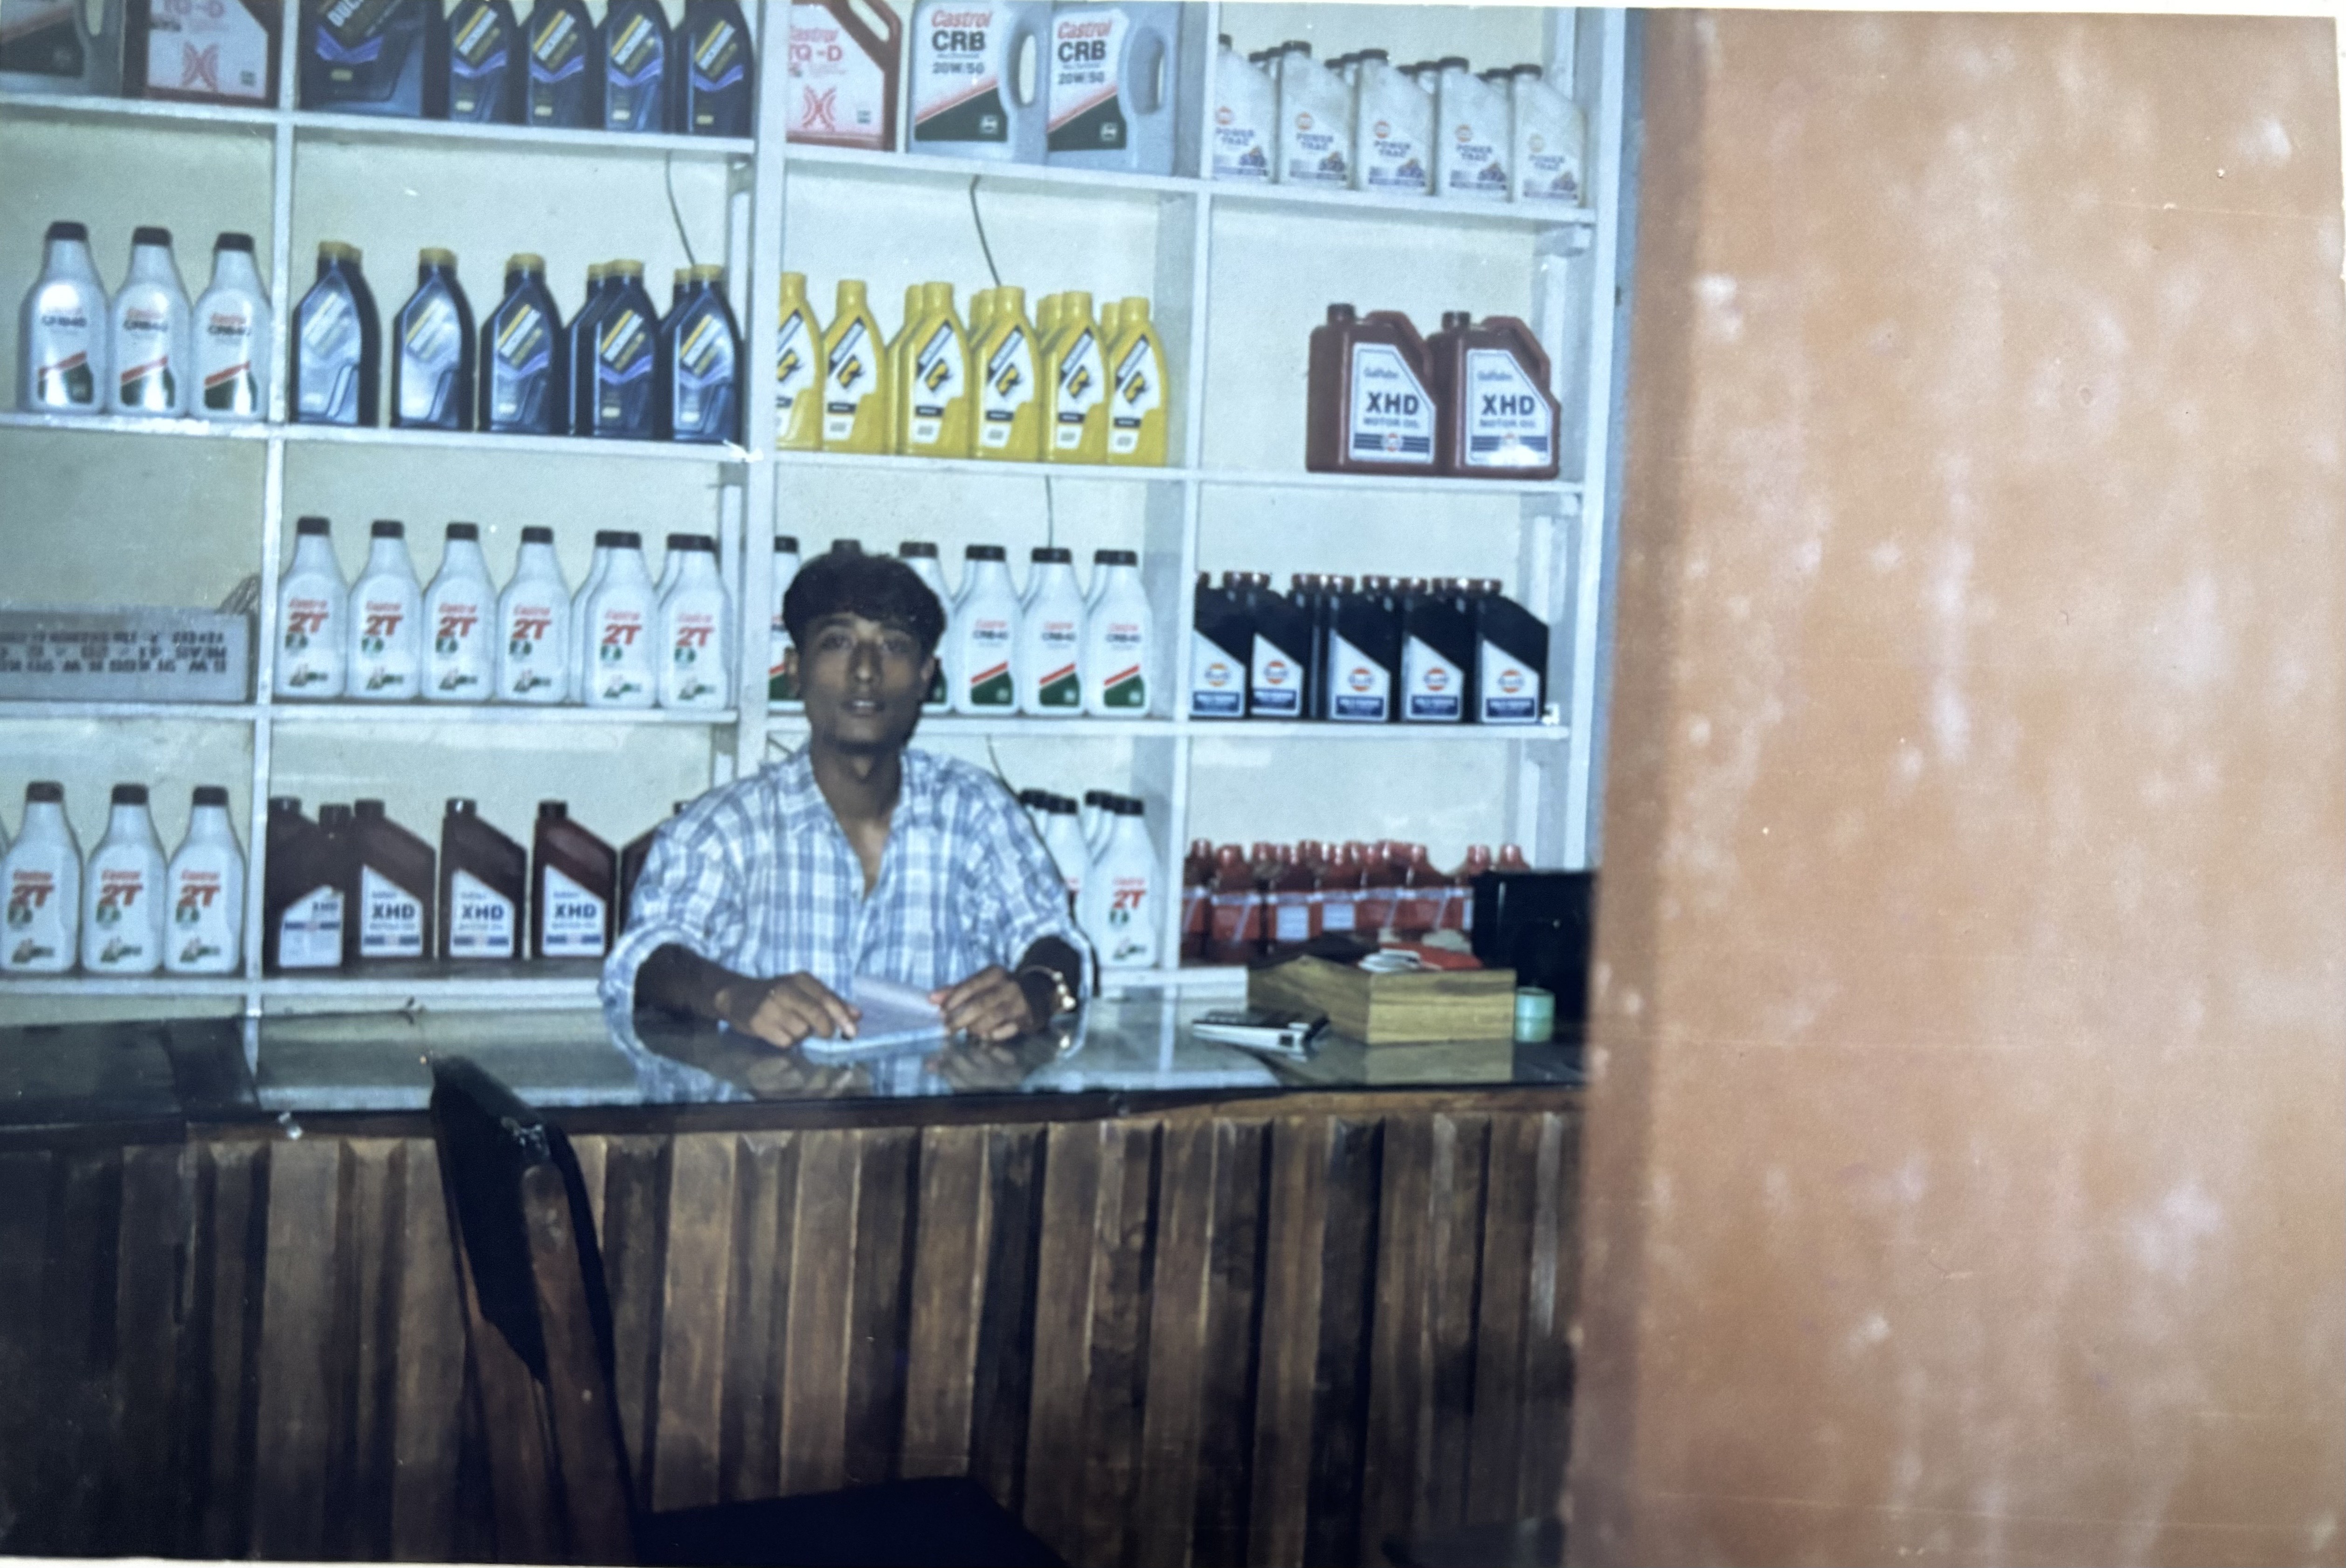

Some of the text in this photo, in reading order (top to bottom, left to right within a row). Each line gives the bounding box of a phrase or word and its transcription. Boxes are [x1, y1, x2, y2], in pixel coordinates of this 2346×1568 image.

[932, 10, 994, 28] Castrol
[1057, 20, 1113, 39] Castrol
[933, 30, 987, 52] CRB
[1058, 40, 1106, 62] CRB
[1367, 392, 1419, 415] XHD
[1482, 394, 1535, 415] XHD
[288, 612, 329, 633] 2T
[364, 615, 403, 636] 2T
[437, 616, 478, 637] 2T
[512, 618, 551, 640] 2T
[603, 624, 642, 645] 2T
[676, 627, 715, 647] 2T
[12, 884, 55, 908] 2T
[100, 883, 143, 907] 2T
[179, 884, 221, 908] 2T
[1113, 890, 1147, 909] 2T
[372, 903, 415, 920] XHD
[461, 904, 505, 921] XHD
[554, 903, 597, 920] XHD
